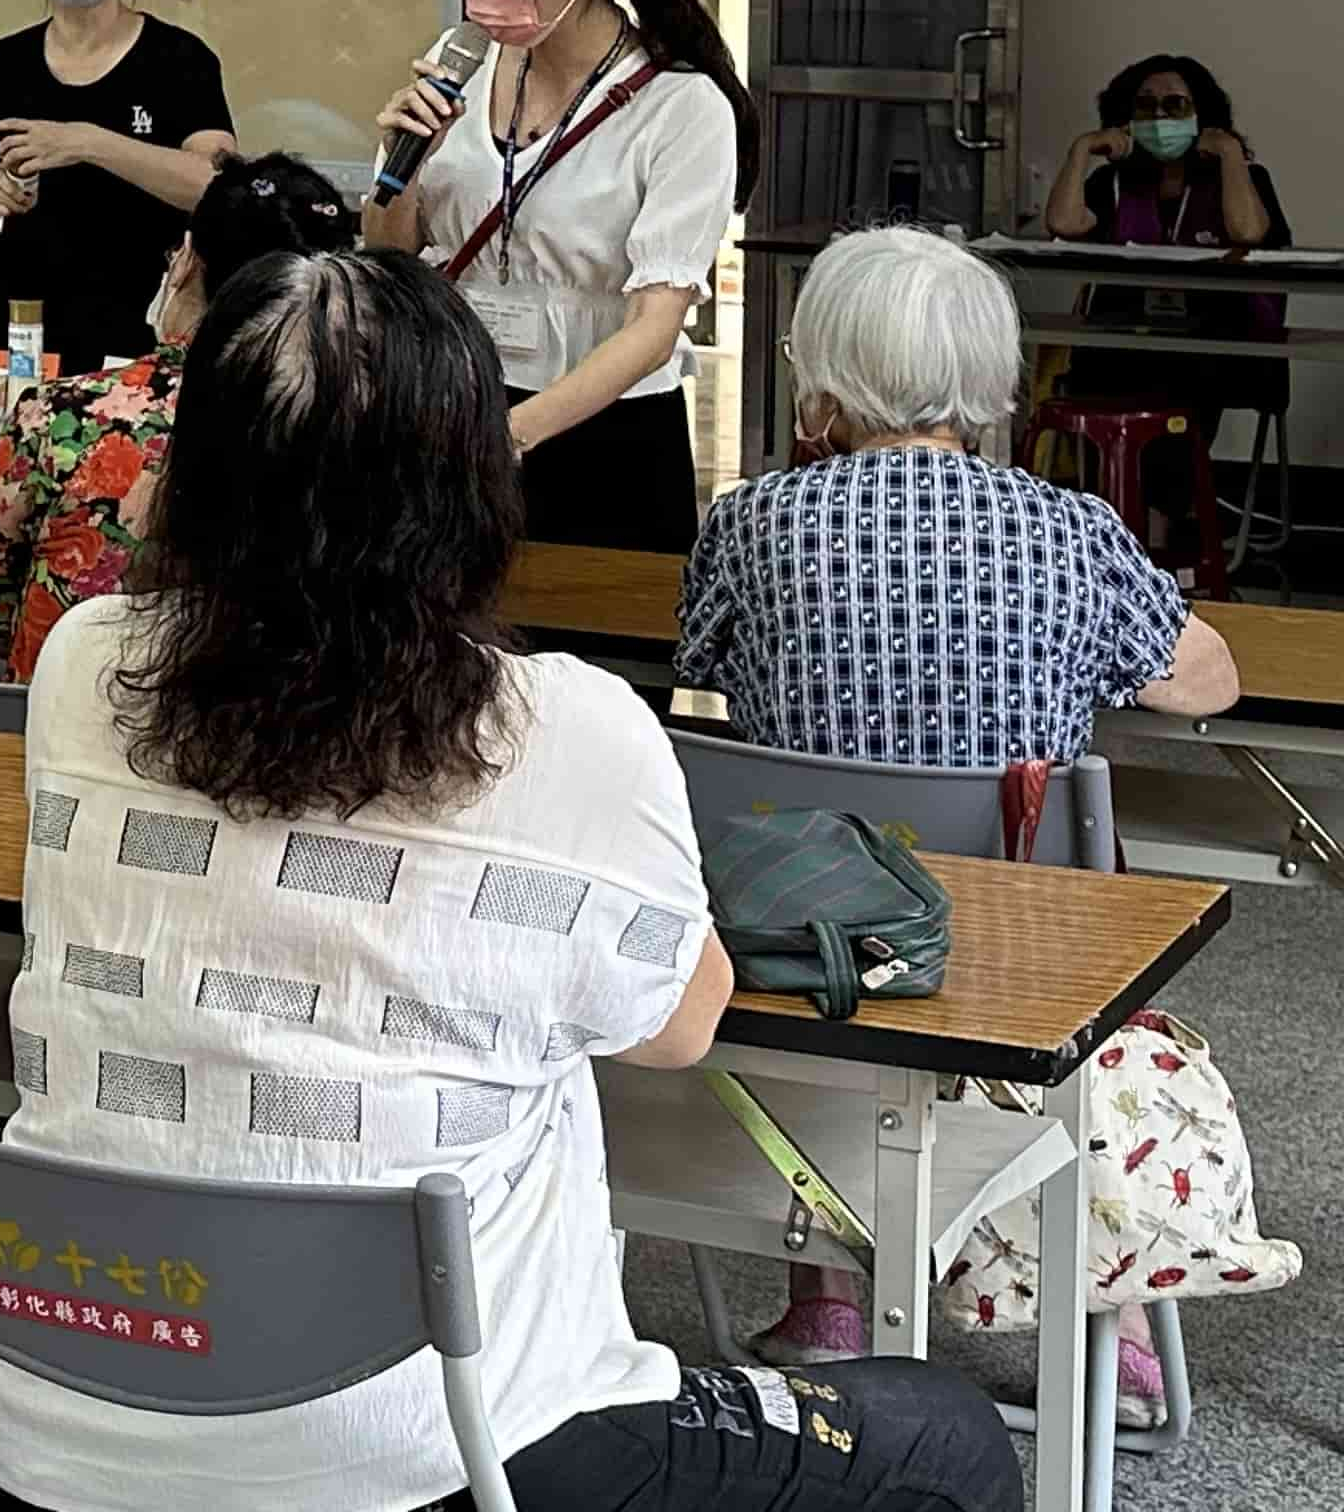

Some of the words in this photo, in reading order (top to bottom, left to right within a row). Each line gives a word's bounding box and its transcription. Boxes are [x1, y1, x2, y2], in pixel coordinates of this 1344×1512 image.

[131, 105, 153, 134] LA
[54, 1239, 209, 1307] 十七份
